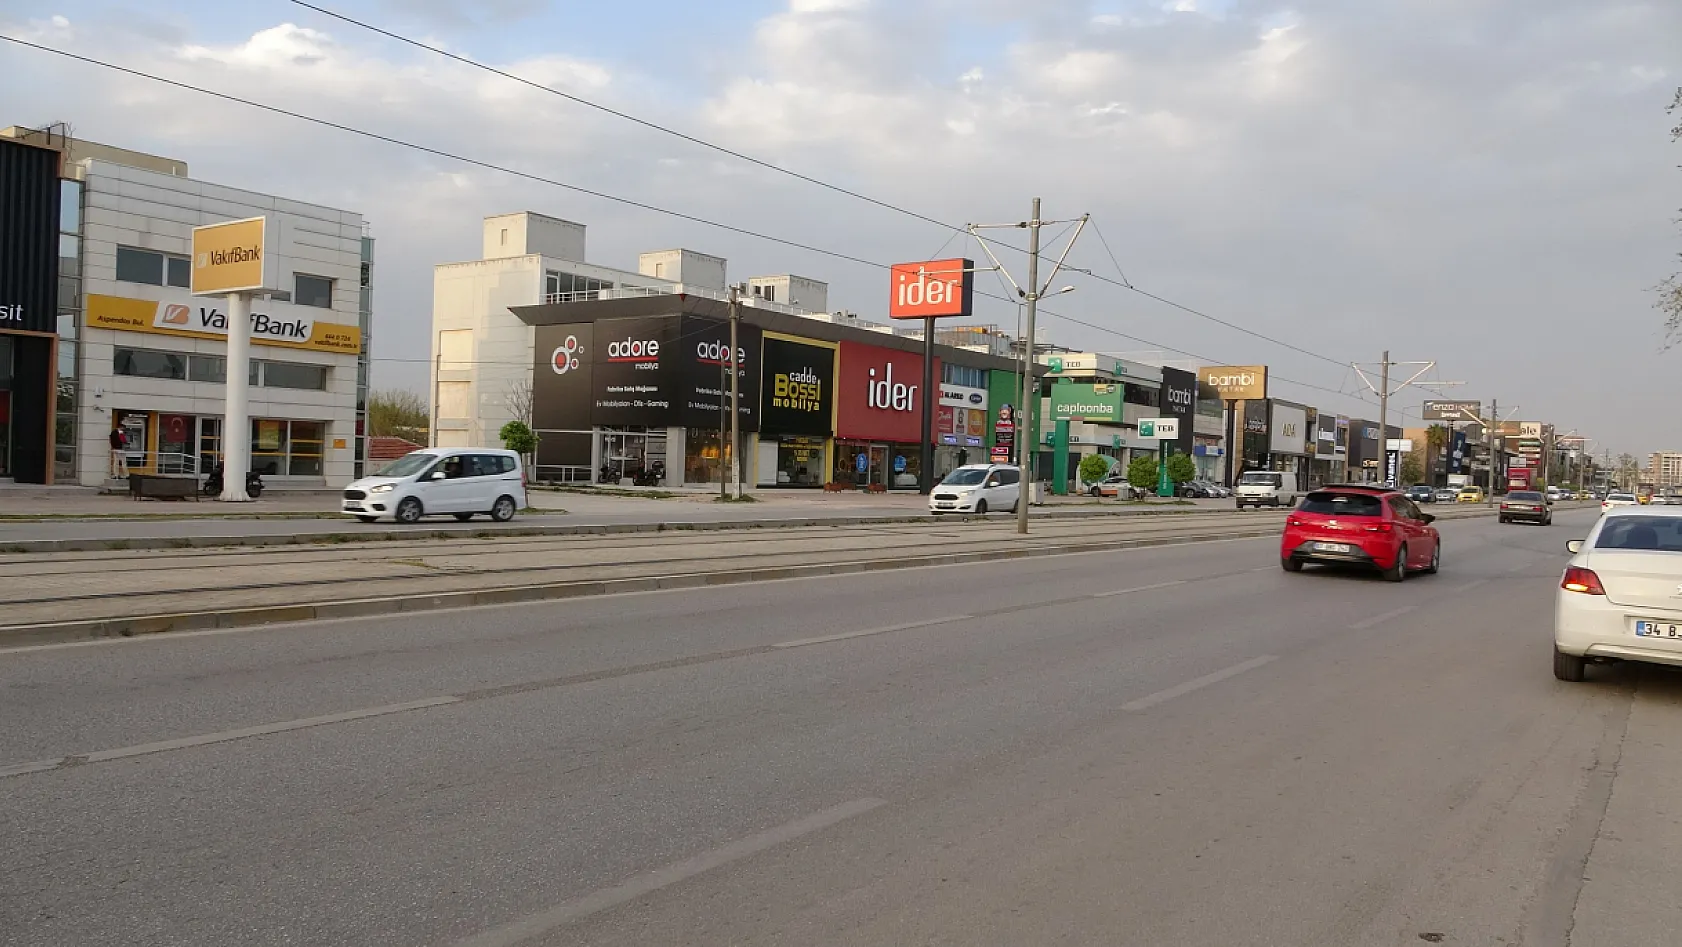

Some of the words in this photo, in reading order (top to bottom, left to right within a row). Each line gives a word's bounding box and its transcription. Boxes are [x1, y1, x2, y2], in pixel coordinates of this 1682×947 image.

[898, 265, 958, 308] ider
[608, 336, 660, 357] adore
[635, 362, 659, 371] mobilya
[789, 366, 817, 385] cadde
[1208, 372, 1255, 386] bambi
[868, 362, 918, 413] ider
[1168, 385, 1191, 406] bambi
[1057, 401, 1113, 415] caploonba
[1157, 424, 1175, 433] TEB
[1645, 623, 1661, 636] 34
